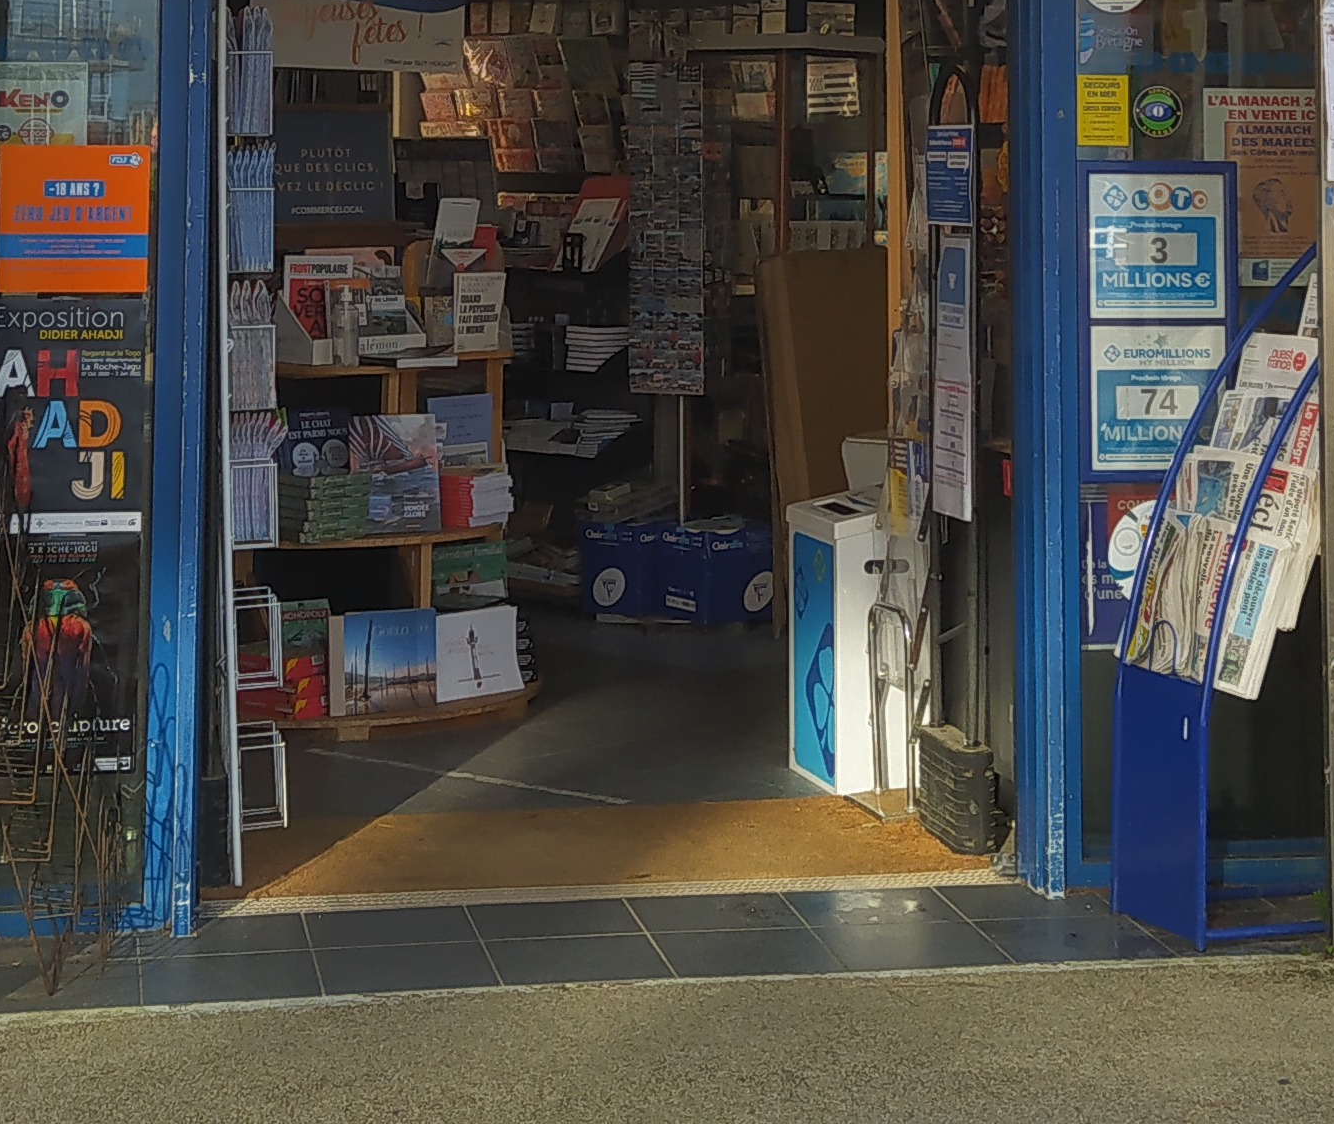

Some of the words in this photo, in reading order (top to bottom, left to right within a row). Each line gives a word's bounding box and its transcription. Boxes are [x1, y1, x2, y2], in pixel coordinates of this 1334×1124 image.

[1207, 95, 1300, 106] L'ALMANACH
[1228, 110, 1247, 120] EN
[1252, 110, 1297, 120] VENTE
[1236, 126, 1311, 135] ALMANACH
[1232, 138, 1257, 147] DES
[301, 147, 351, 159] PLUTÔT
[111, 156, 128, 165] FDJ
[334, 163, 378, 173] CLICS,
[48, 181, 67, 196] -18
[325, 179, 374, 191] DÉCLIC
[1132, 181, 1209, 211] LOTO
[12, 204, 43, 222] ZÉRO
[74, 205, 133, 222] D'ARGENT
[1150, 237, 1168, 264] 3
[1102, 272, 1192, 287] MILLIONS
[39, 330, 78, 339] DIDIER
[81, 330, 123, 339] AHADJI
[1123, 348, 1210, 359] EUROMILLIONS
[94, 363, 141, 371] Roche-Jagu
[1141, 389, 1178, 415] 74
[314, 419, 332, 428] CHAT
